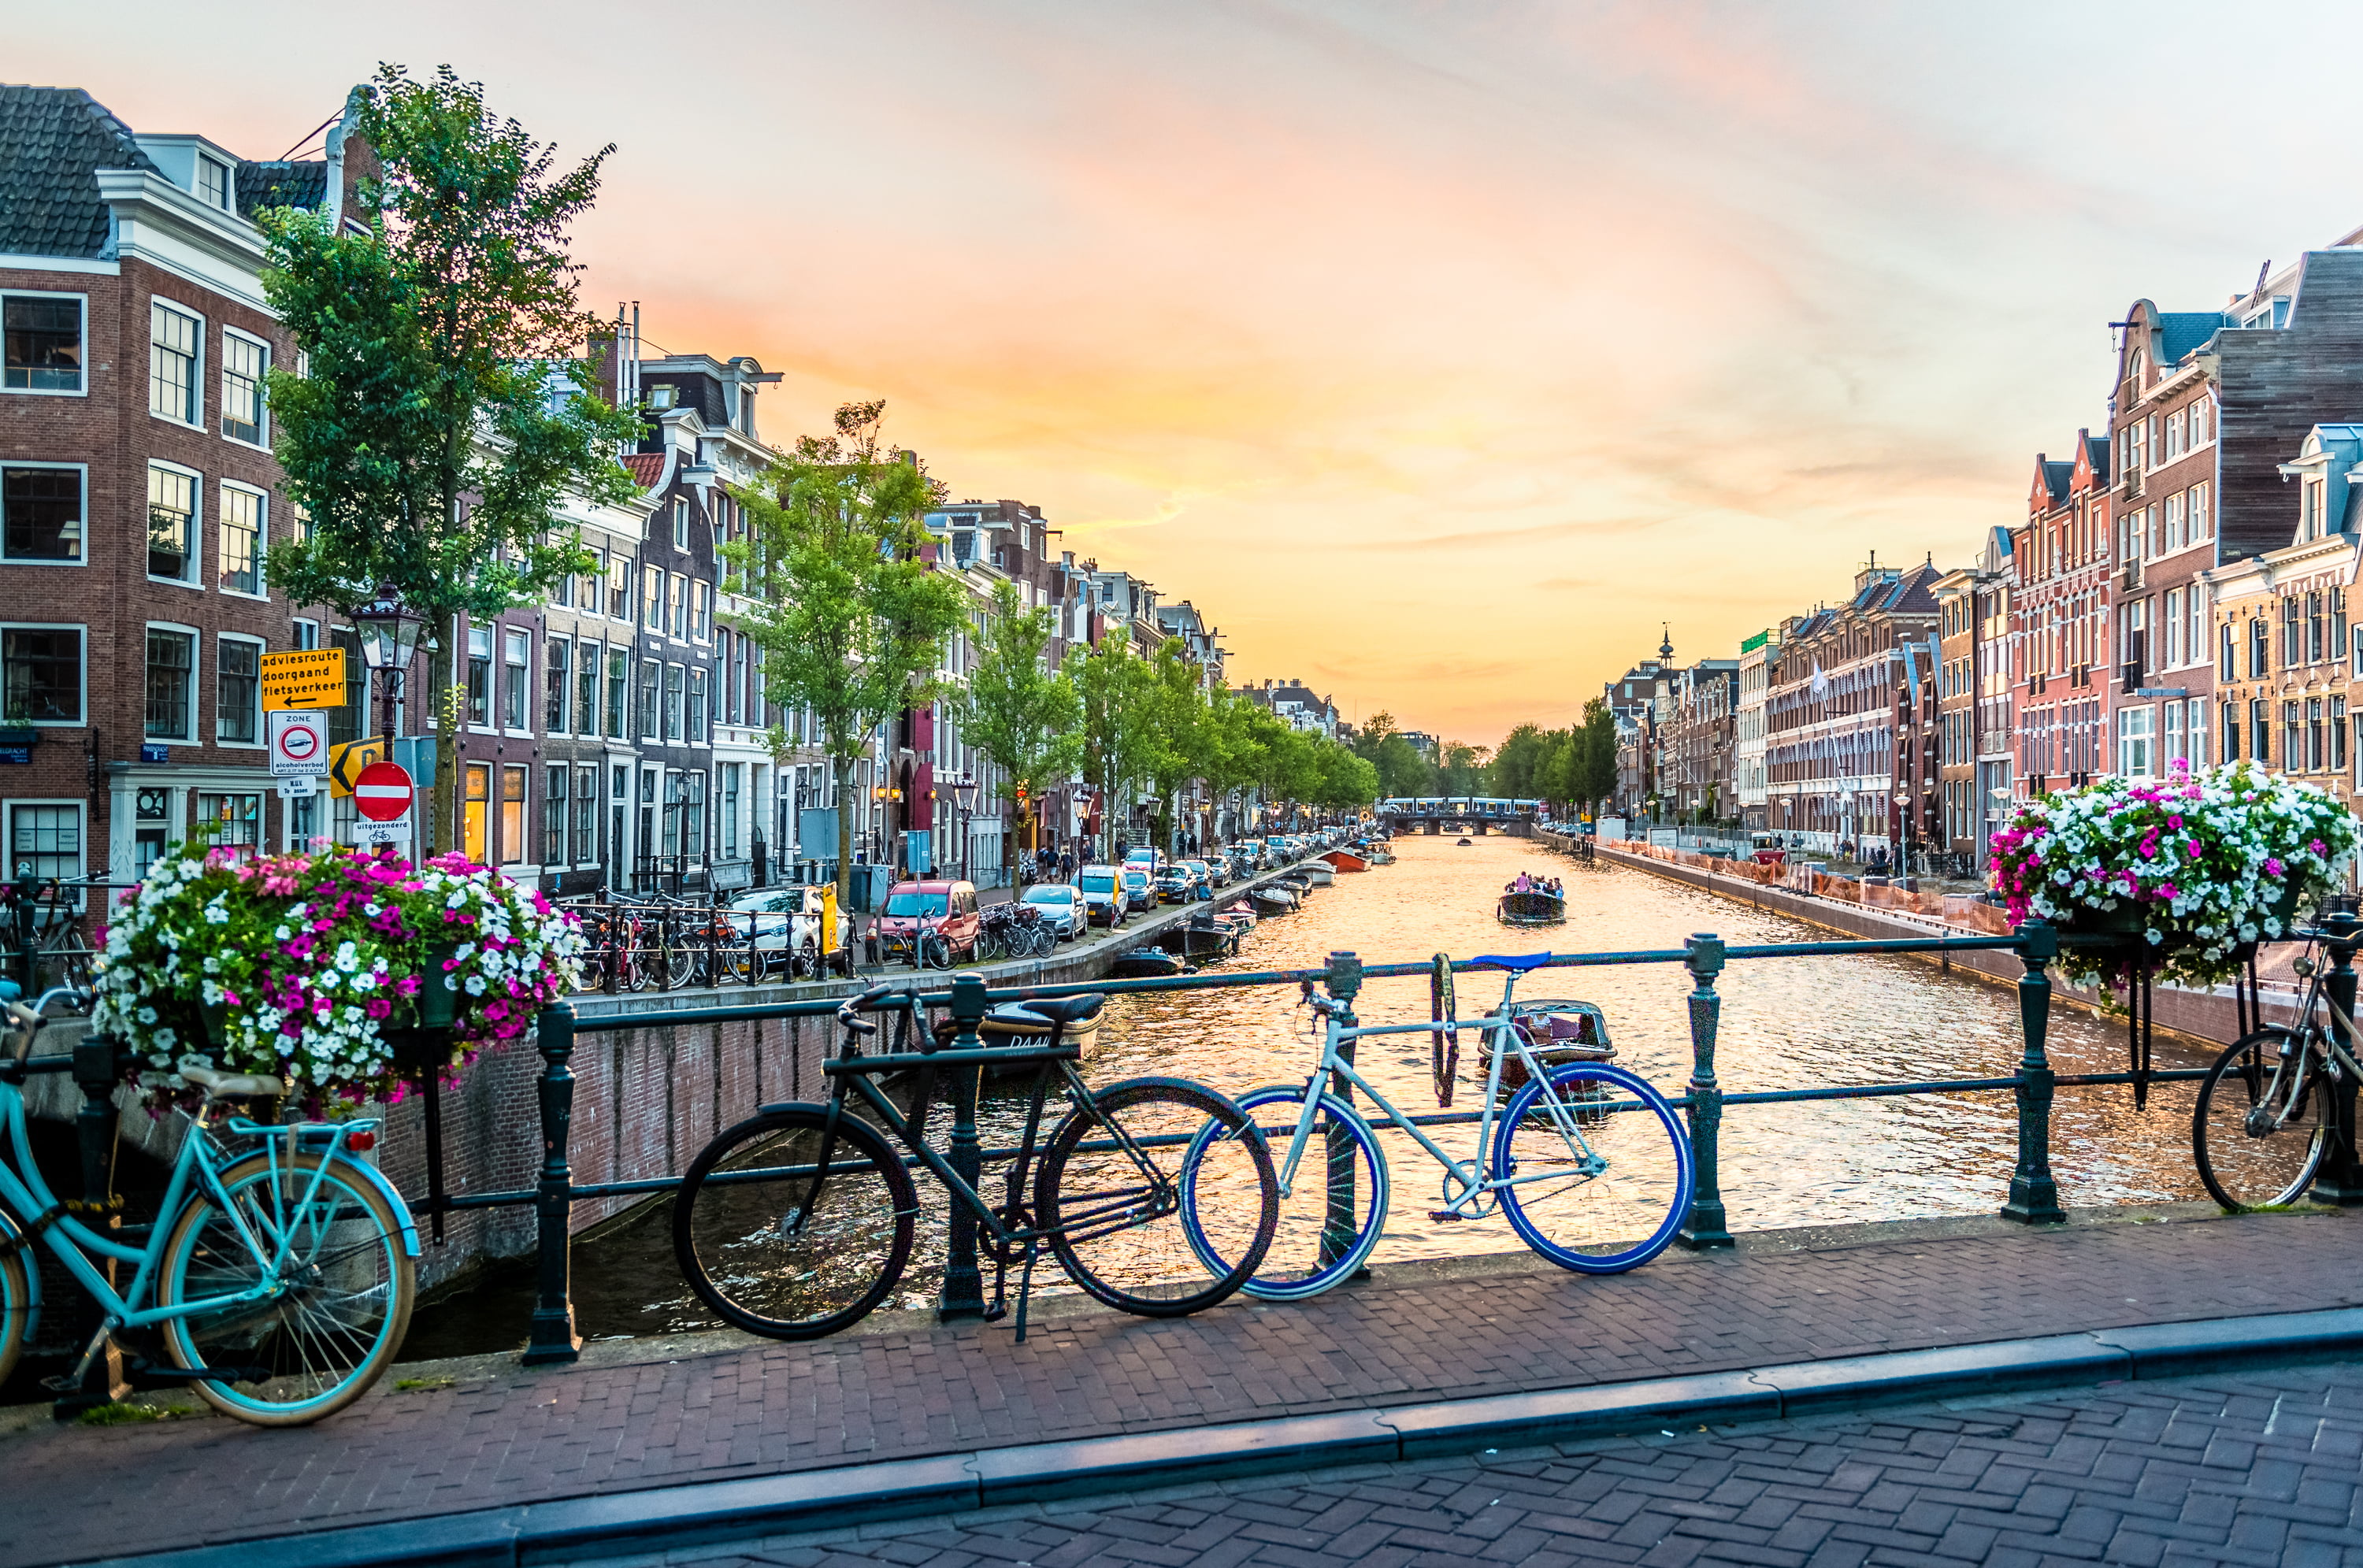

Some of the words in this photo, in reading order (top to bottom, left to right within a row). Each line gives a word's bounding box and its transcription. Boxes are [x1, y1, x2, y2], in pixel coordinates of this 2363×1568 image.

[262, 651, 339, 667] adviesroute
[262, 666, 329, 682] doorgaand
[264, 682, 343, 696] fietsverkeer
[357, 821, 407, 831] uitgezonderd
